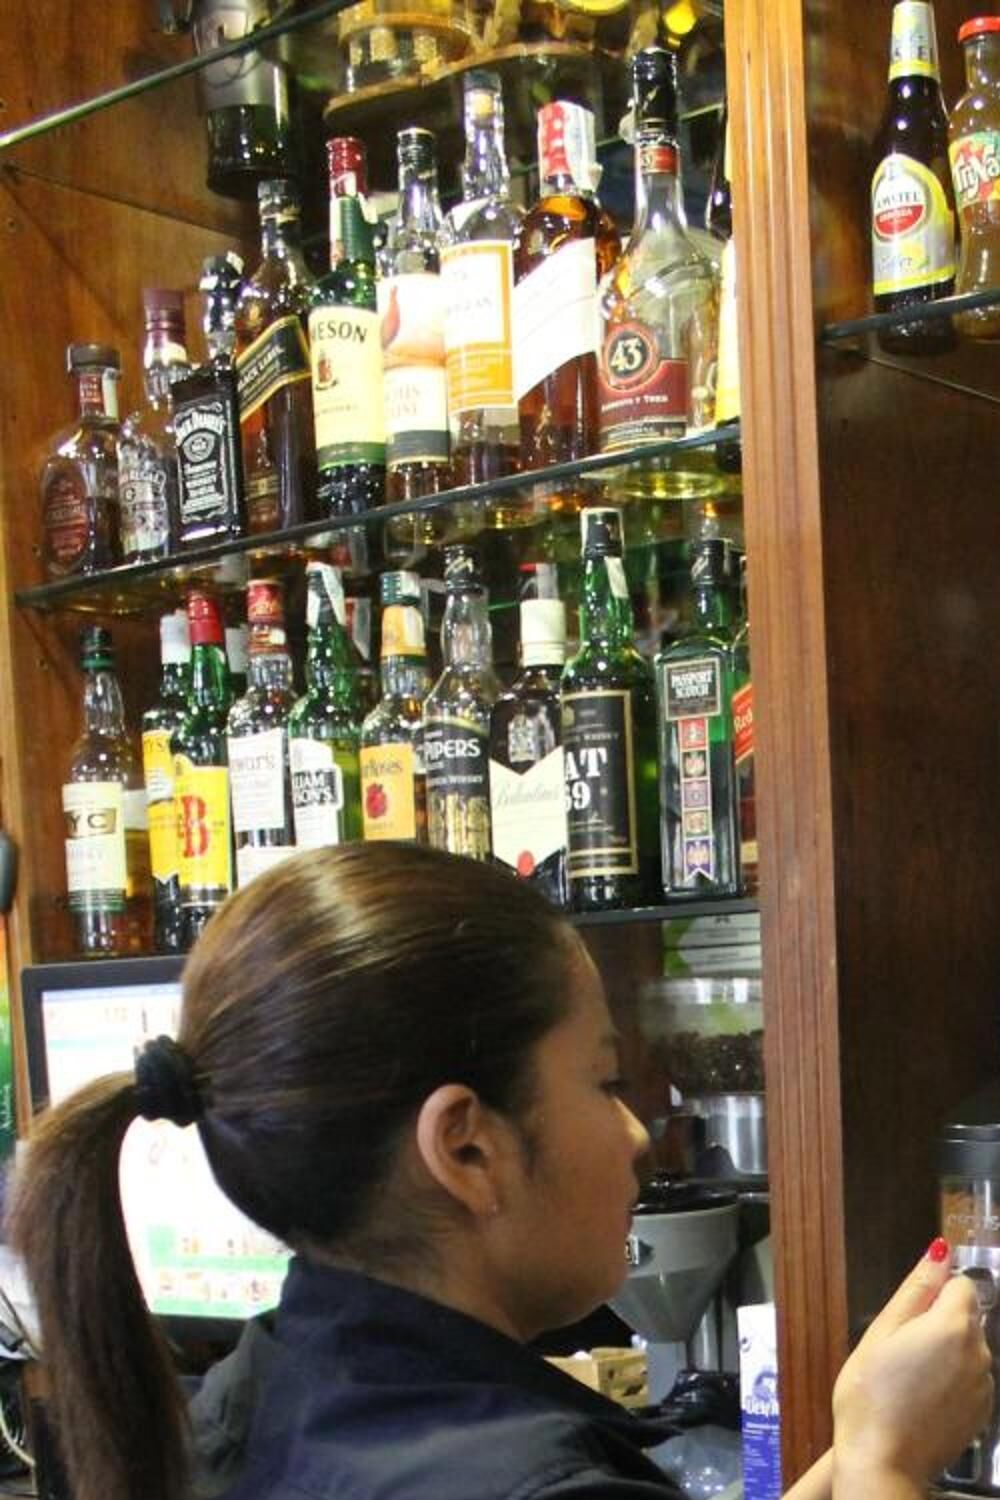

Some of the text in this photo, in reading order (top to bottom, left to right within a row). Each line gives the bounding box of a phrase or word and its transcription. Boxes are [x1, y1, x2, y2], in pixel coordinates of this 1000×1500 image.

[611, 337, 643, 372] 43
[565, 747, 608, 782] AT
[68, 812, 109, 831] YC
